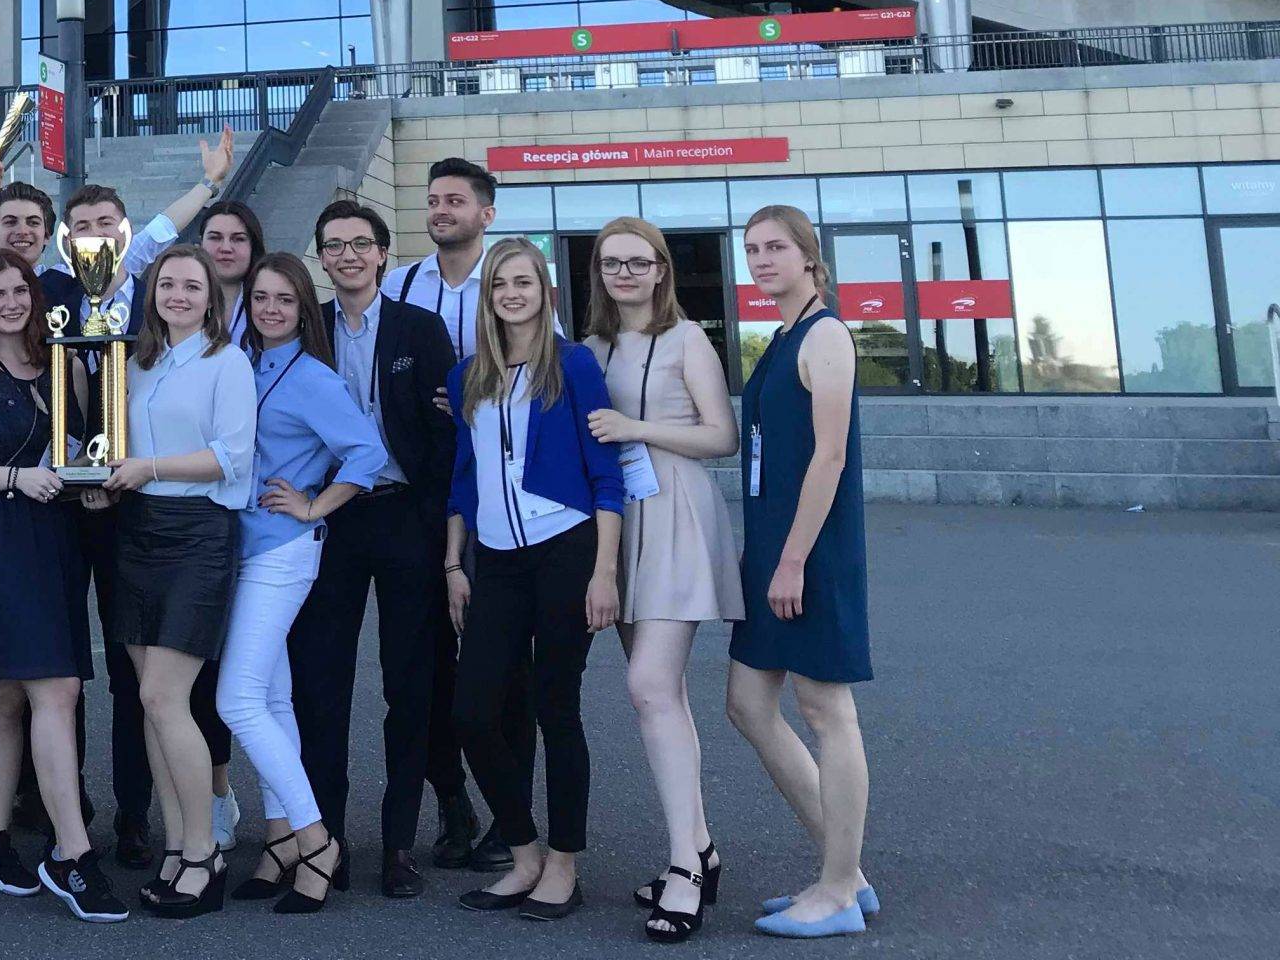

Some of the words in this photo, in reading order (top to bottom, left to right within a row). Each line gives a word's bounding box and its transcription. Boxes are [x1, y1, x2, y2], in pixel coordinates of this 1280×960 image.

[766, 24, 775, 36] S
[577, 34, 587, 46] S
[523, 150, 579, 164] Recepcja
[582, 149, 629, 162] główna
[644, 147, 674, 159] Main
[676, 145, 733, 159] reception
